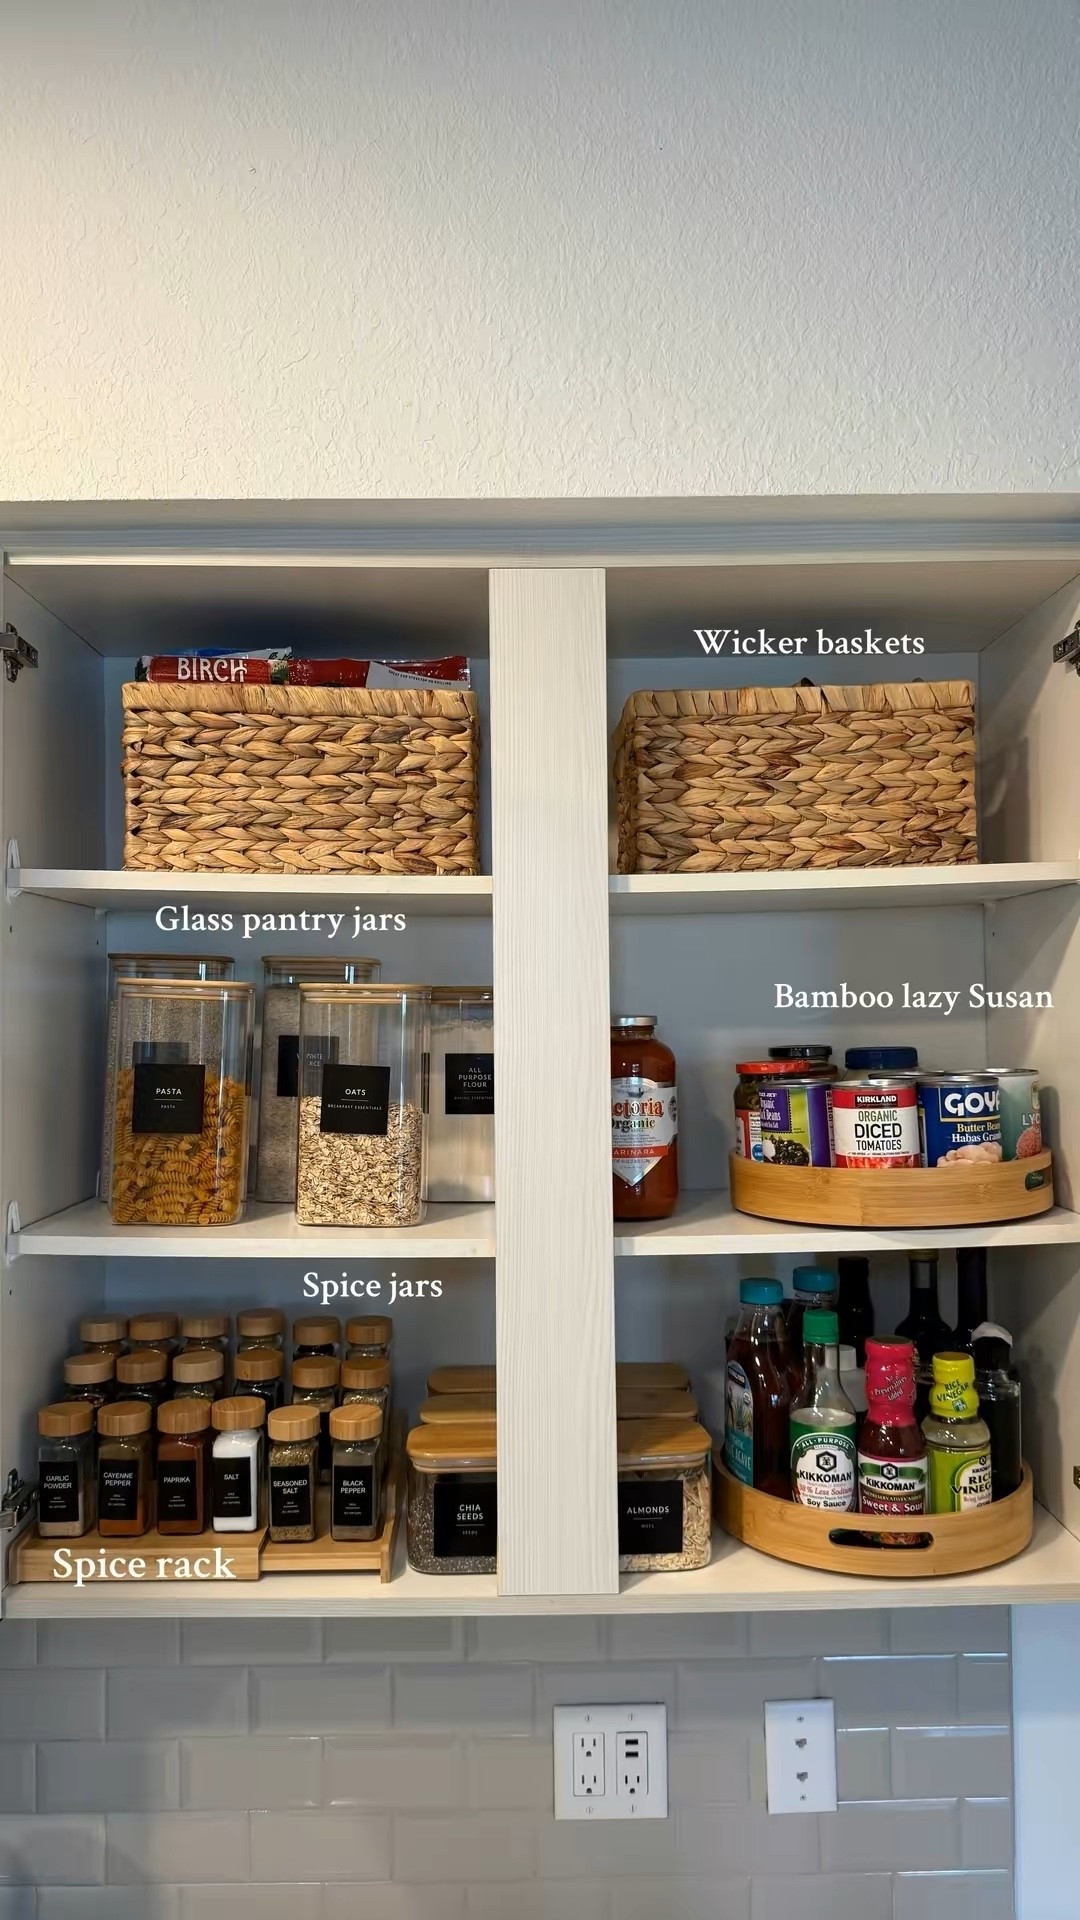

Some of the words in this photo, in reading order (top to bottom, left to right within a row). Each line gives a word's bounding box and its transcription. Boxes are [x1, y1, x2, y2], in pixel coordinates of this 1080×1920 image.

[177, 657, 247, 683] BIRCH
[345, 1088, 366, 1096] OATS
[856, 1095, 897, 1103] KIRKLAND
[612, 1098, 665, 1119] ctoria
[858, 1110, 898, 1122] ORGANIC
[612, 1117, 656, 1133] rganic
[957, 1122, 985, 1133] Butter
[854, 1123, 903, 1139] DICED
[951, 1132, 981, 1143] Habas
[856, 1140, 902, 1151] TOMATOES
[944, 1379, 960, 1391] RICE
[936, 1382, 969, 1402] VINEGAR
[802, 1437, 849, 1449] ALL-PURPOSE
[224, 1473, 239, 1481] SALT
[799, 1469, 852, 1483] KIKKOMAN
[866, 1477, 916, 1491] KIKKOMAN
[282, 1487, 298, 1495] SALT
[814, 1487, 830, 1496] Less
[806, 1498, 821, 1507] Soy
[862, 1495, 888, 1511] Sweet
[891, 1503, 901, 1512] &
[904, 1502, 923, 1512] Sour
[627, 1505, 670, 1514] ALMONDS
[456, 1512, 484, 1521] SEEDS
